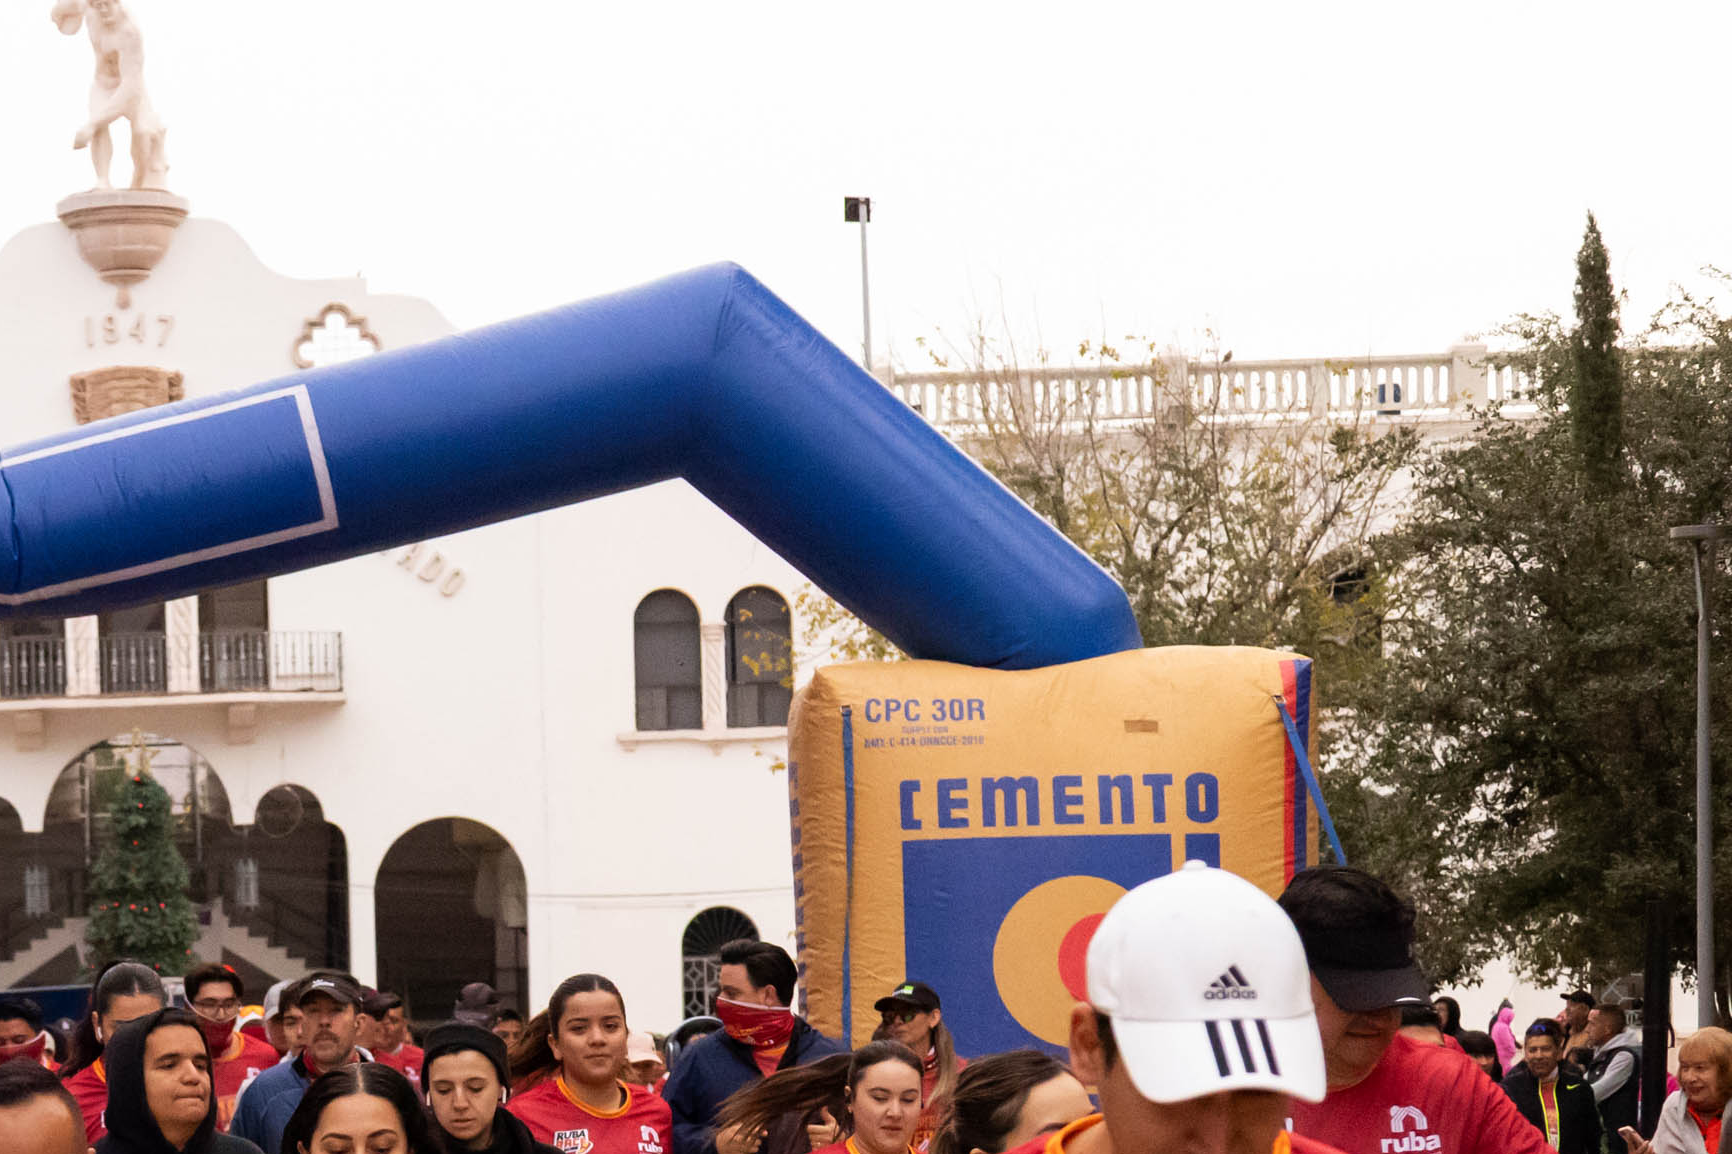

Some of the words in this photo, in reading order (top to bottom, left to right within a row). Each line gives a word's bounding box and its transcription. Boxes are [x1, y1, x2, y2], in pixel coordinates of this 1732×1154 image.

[84, 314, 175, 349] 1847
[394, 542, 468, 599] ADO
[864, 698, 922, 723] CPC
[931, 698, 986, 722] 30R
[556, 1130, 587, 1141] RUBA
[1380, 1135, 1442, 1154] ruba
